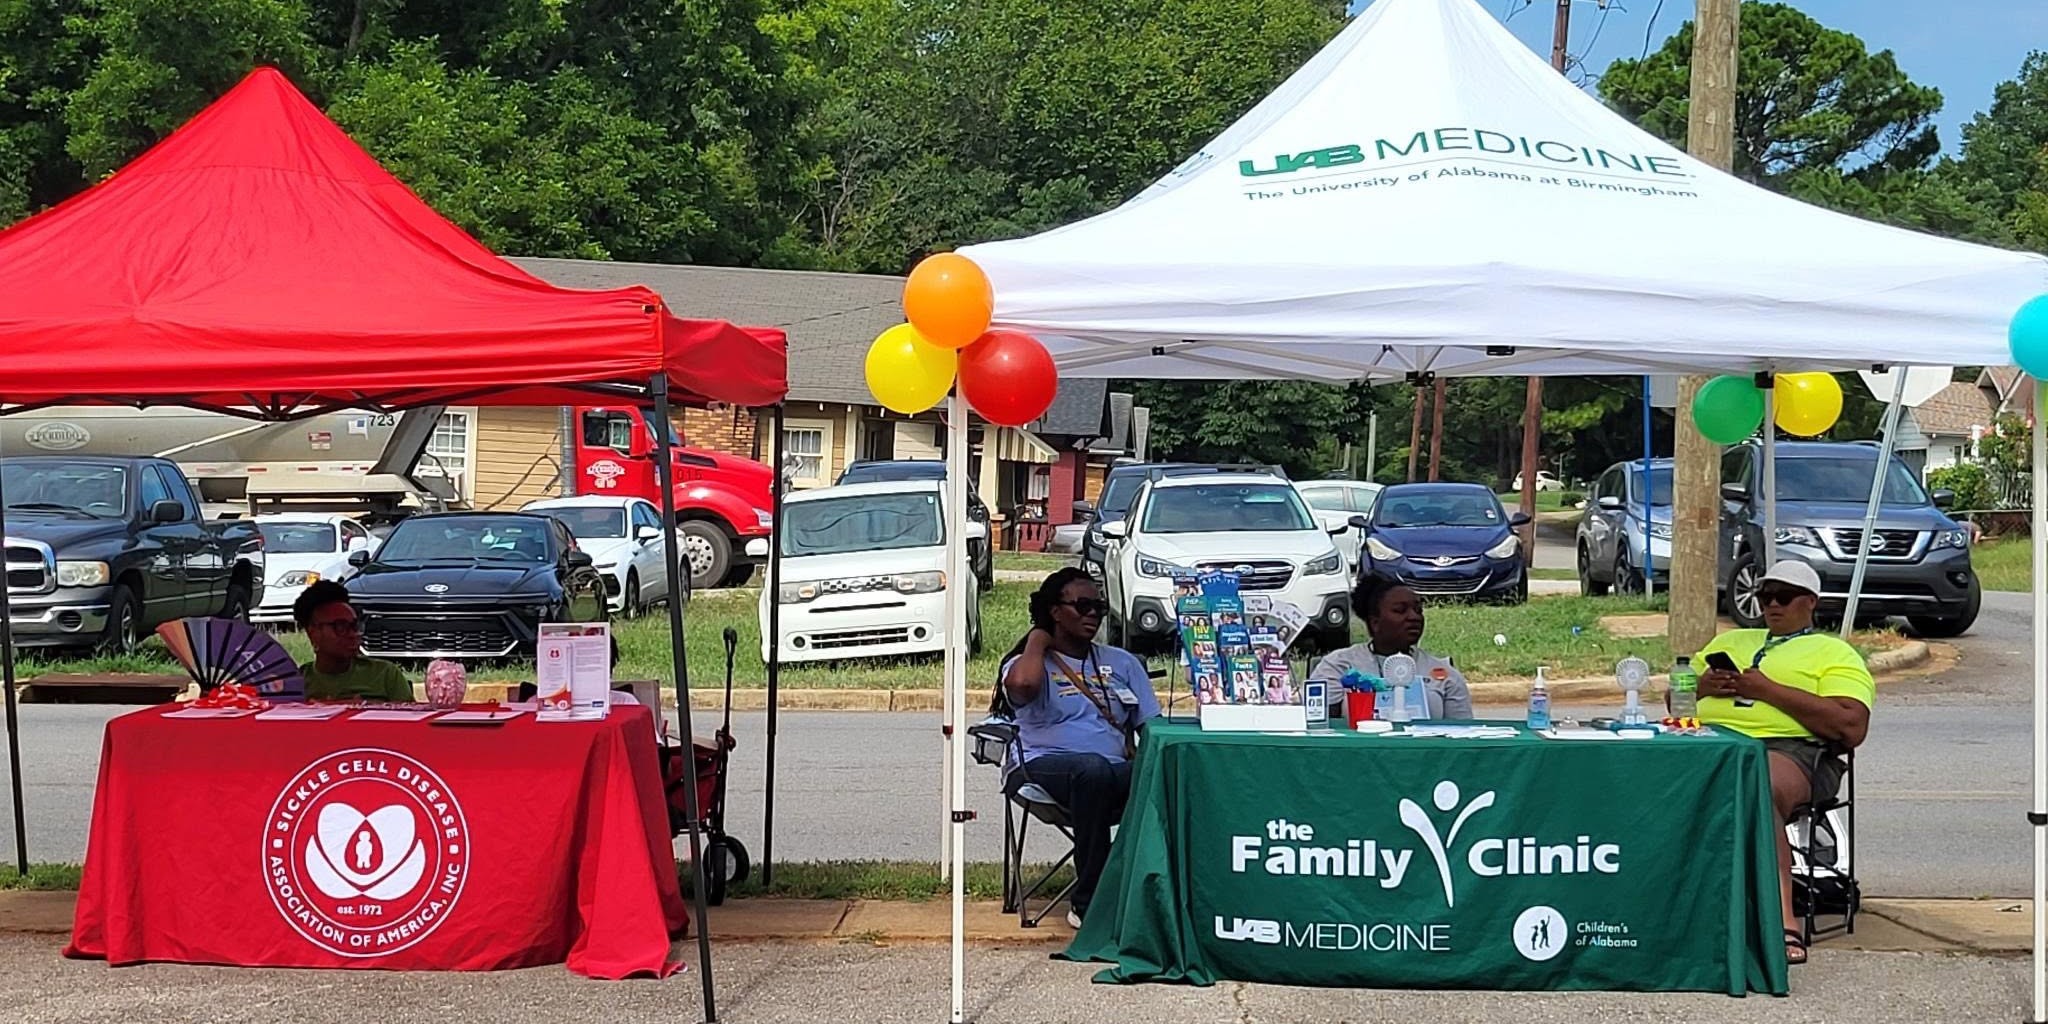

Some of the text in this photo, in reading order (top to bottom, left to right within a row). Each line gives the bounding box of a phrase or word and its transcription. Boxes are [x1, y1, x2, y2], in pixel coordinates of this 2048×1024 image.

[1239, 128, 1687, 177] UAB MEDICINE
[1243, 167, 1698, 201] The University of Alabama at Birmingham
[368, 415, 395, 427] 723
[276, 759, 459, 839] SICKLE CELL DISEASE
[1266, 819, 1314, 841] the
[1231, 835, 1620, 889] Family Clinic
[270, 855, 461, 947] ASSOCIATION OF AMERICA, INC
[336, 904, 383, 916] est. 1972
[1215, 915, 1451, 951] UAB MEDICINE
[1575, 935, 1638, 948] of Alabama
[1576, 920, 1629, 934] Children's
